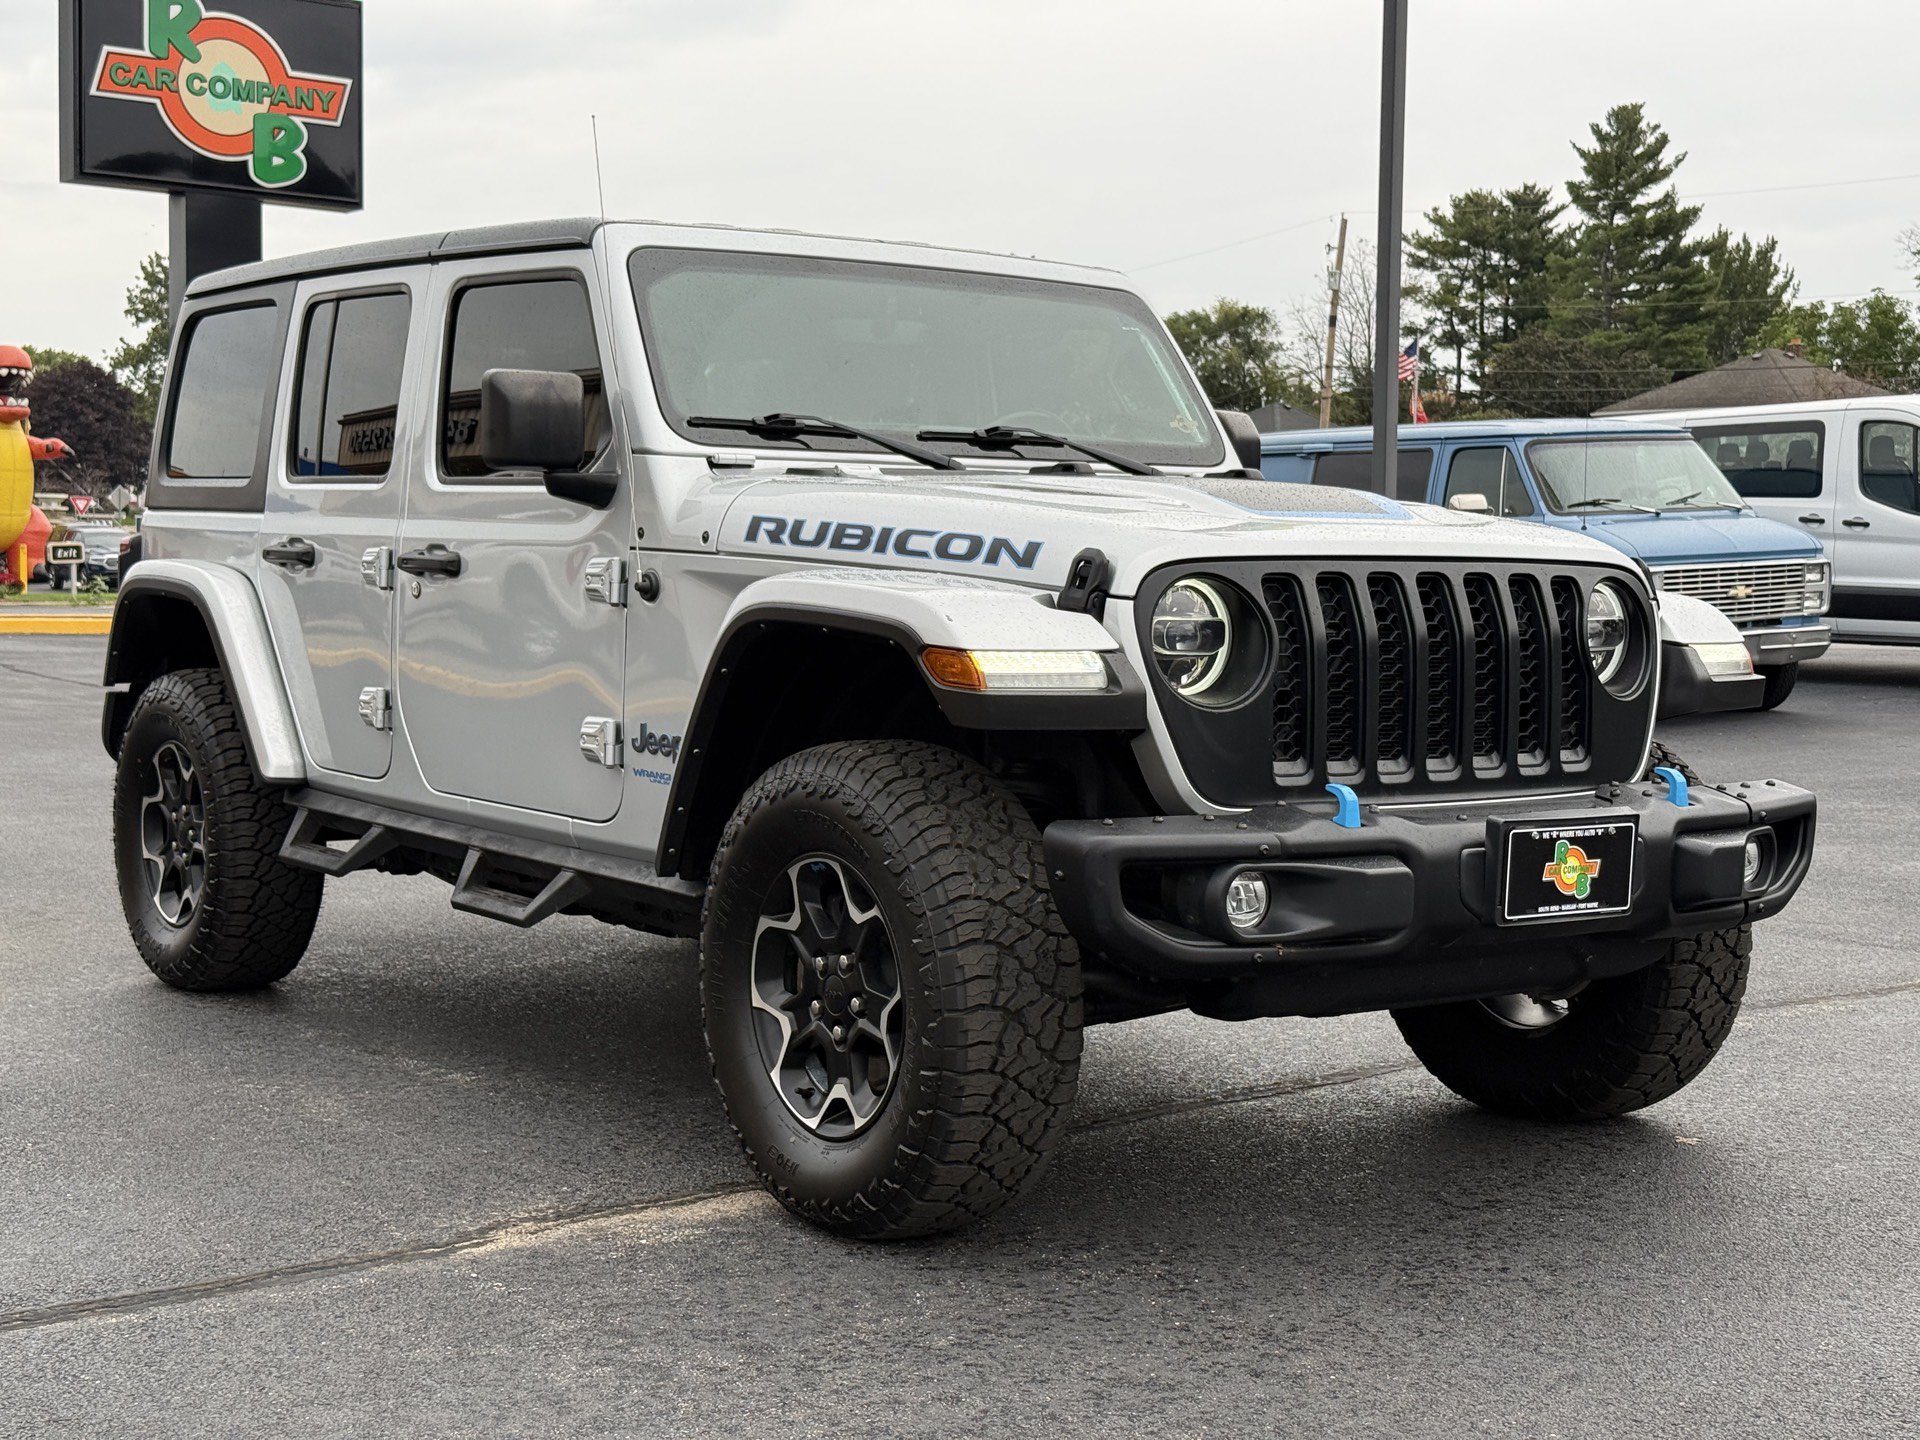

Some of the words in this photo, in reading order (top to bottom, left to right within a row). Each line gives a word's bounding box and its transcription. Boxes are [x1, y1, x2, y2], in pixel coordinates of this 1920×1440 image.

[149, 0, 202, 63] R
[109, 62, 178, 92] CAR
[185, 73, 337, 112] COMPANY
[253, 112, 305, 184] B
[57, 548, 78, 558] Exit
[743, 514, 1045, 570] RUBICON
[1555, 842, 1568, 865] R
[1576, 873, 1588, 896] B
